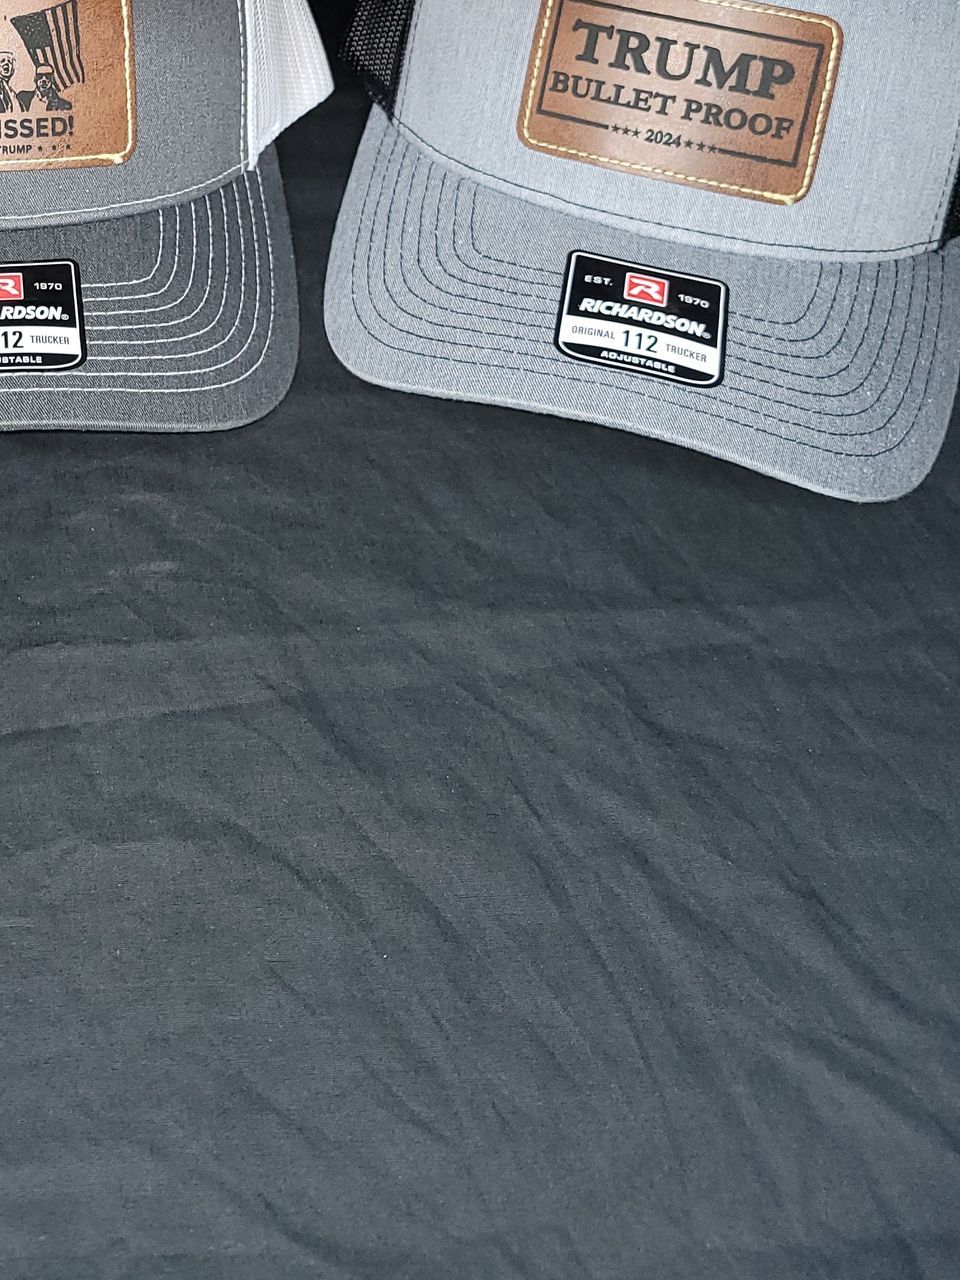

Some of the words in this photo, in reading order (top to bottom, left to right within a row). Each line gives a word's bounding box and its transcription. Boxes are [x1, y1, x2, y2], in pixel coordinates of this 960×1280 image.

[572, 18, 795, 100] TRUMP
[549, 70, 676, 116] BULLET
[681, 99, 794, 139] PROOF
[644, 129, 681, 148] 2024
[584, 275, 614, 286] EST.
[678, 294, 710, 309] 1970
[30, 335, 70, 344] TRUCKER
[572, 325, 615, 339] ORIGINAL
[622, 330, 658, 353] 112
[665, 344, 707, 363] TRUCKER
[600, 350, 676, 373] ADJUSTABLE
